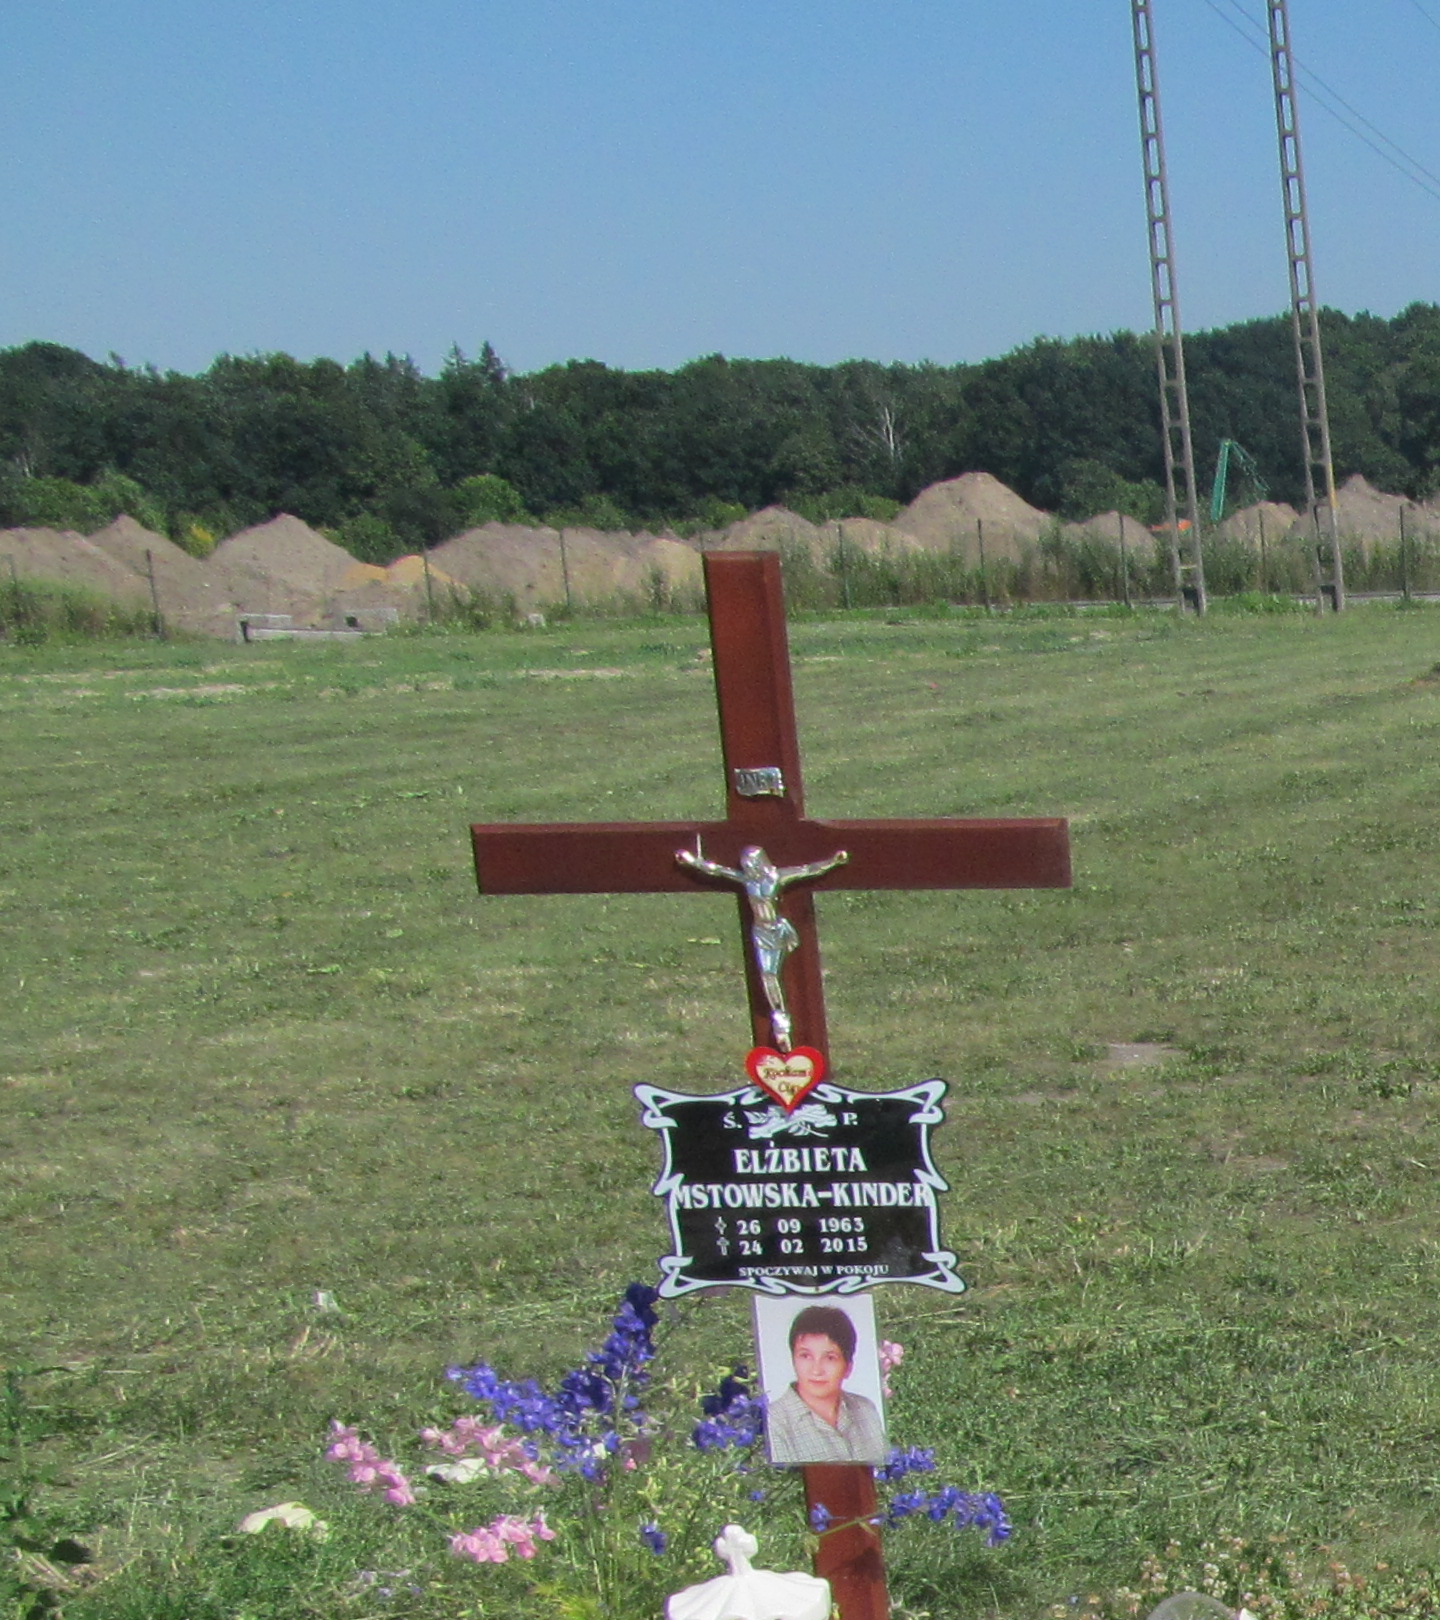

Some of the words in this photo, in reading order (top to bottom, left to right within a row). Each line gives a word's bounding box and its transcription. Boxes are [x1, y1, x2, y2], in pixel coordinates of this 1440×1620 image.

[842, 1113, 858, 1126] P.
[733, 1140, 868, 1174] ELŻBIETA
[673, 1181, 932, 1210] MSTOWSKA-KINDER
[736, 1219, 761, 1235] 26
[777, 1218, 801, 1234] 09
[818, 1217, 864, 1233] 1963
[738, 1240, 763, 1255] 24
[780, 1239, 804, 1254] 02
[820, 1237, 868, 1252] 2015
[738, 1265, 818, 1278] SPOCZYWAJ
[819, 1265, 834, 1276] W
[836, 1264, 890, 1276] POKOJU
